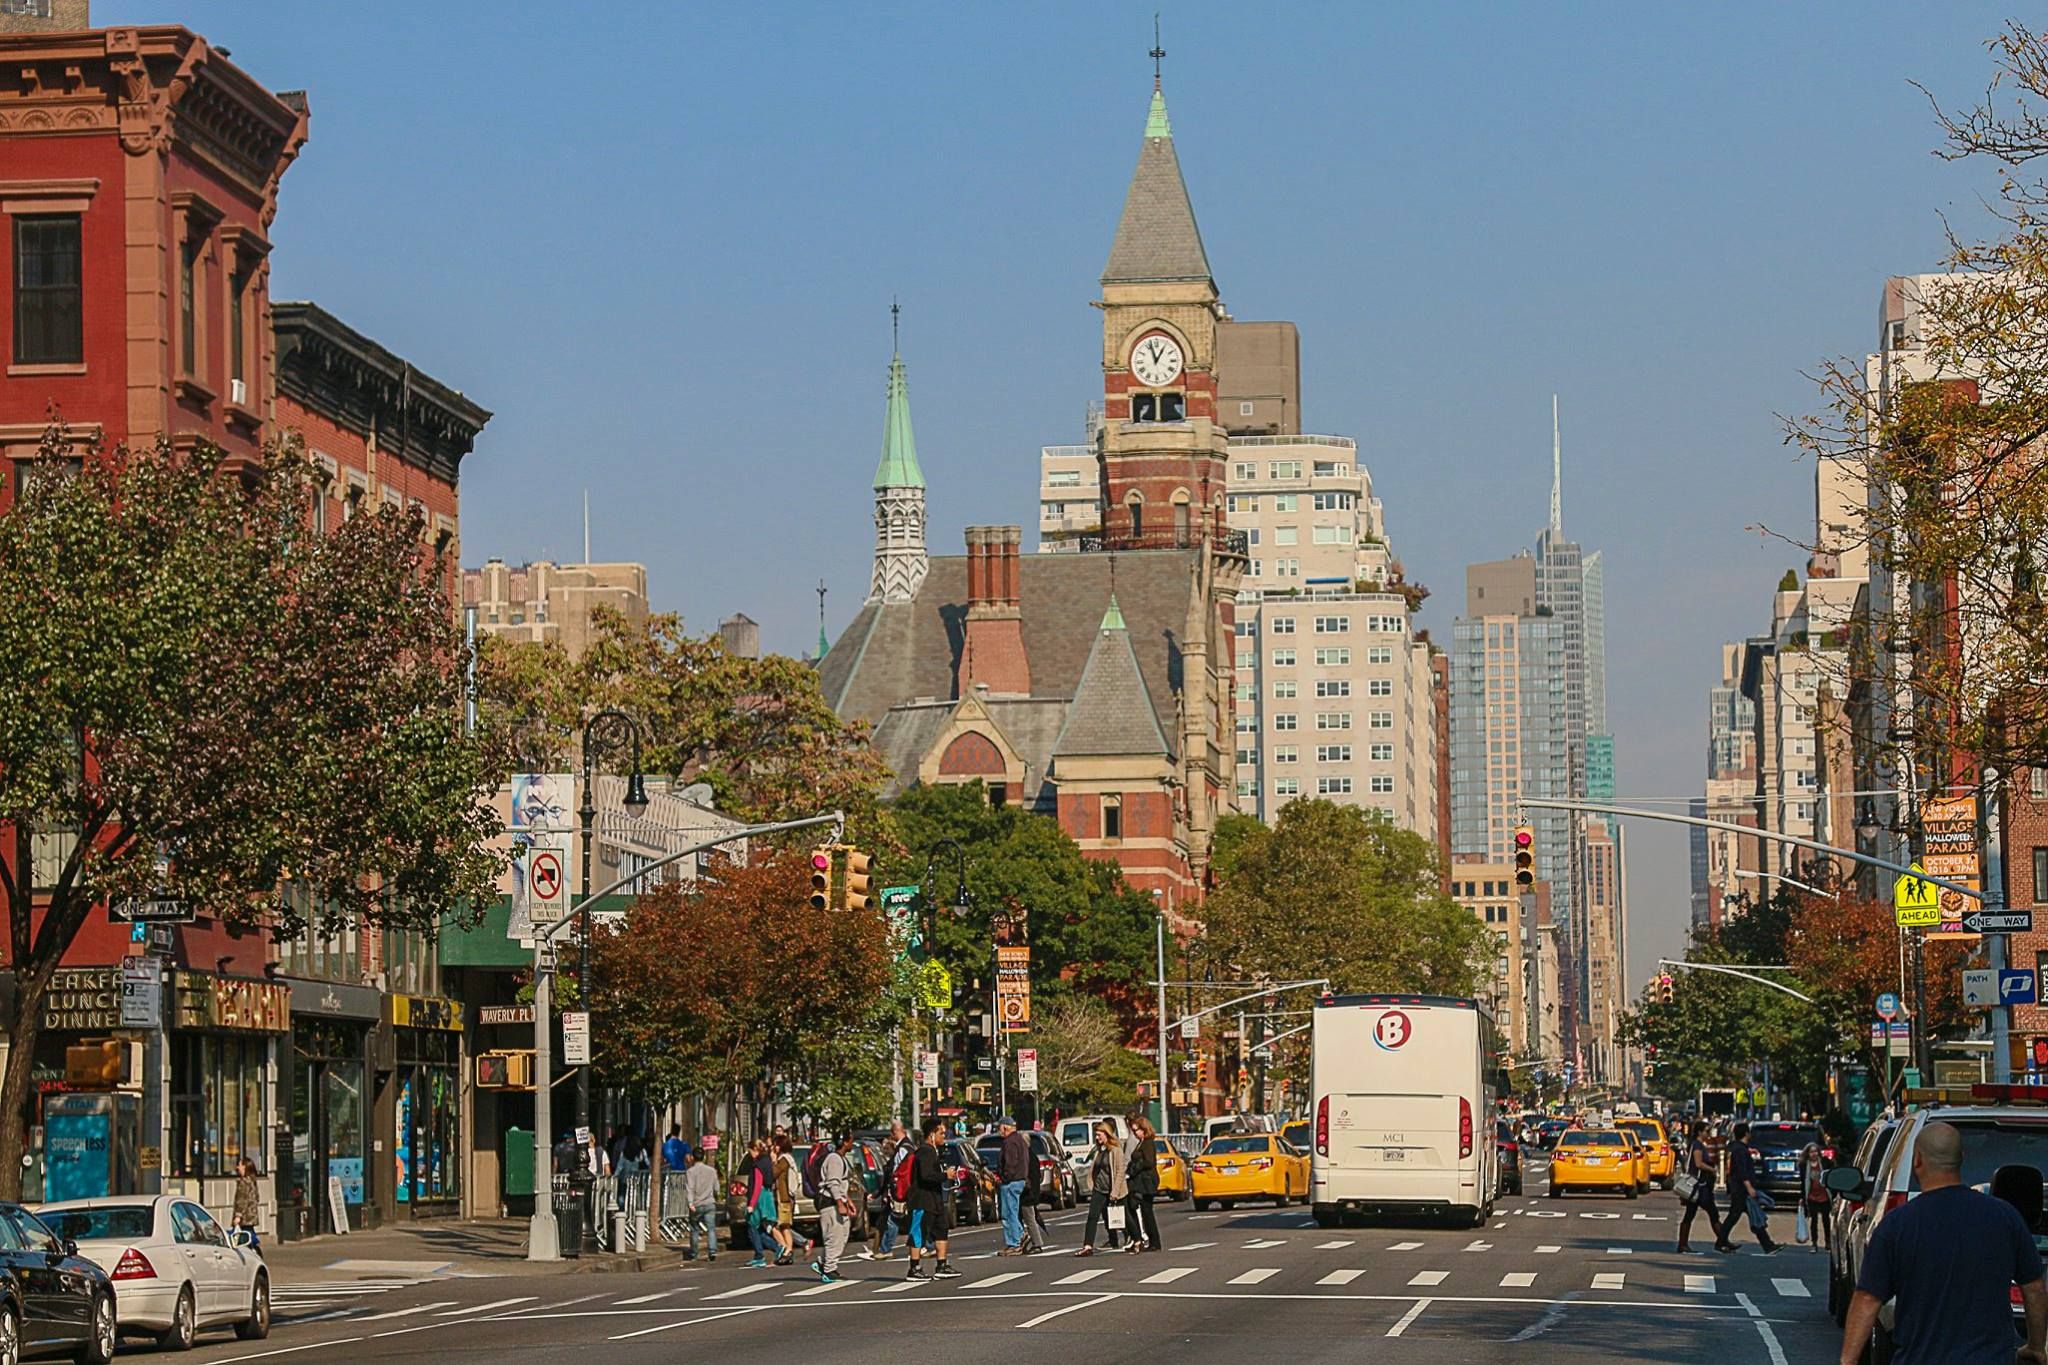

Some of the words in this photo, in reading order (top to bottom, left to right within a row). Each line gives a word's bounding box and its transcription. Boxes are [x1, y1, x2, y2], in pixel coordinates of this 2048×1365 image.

[1924, 822, 1974, 833] VILLAGE
[1926, 842, 1975, 853] PARADE
[1926, 857, 1963, 865] OCTOBER
[1927, 866, 1949, 874] 2016
[1957, 864, 1975, 873] 7PM
[121, 903, 144, 914] ONE
[1900, 911, 1937, 921] AHEAD
[1969, 917, 1992, 927] ONE
[2003, 916, 2026, 926] WAY
[46, 973, 122, 990] EAKFA
[481, 1008, 516, 1022] WAVERLY
[519, 1008, 530, 1022] PL
[32, 1070, 57, 1080] OPEN
[1383, 1133, 1404, 1143] MCI
